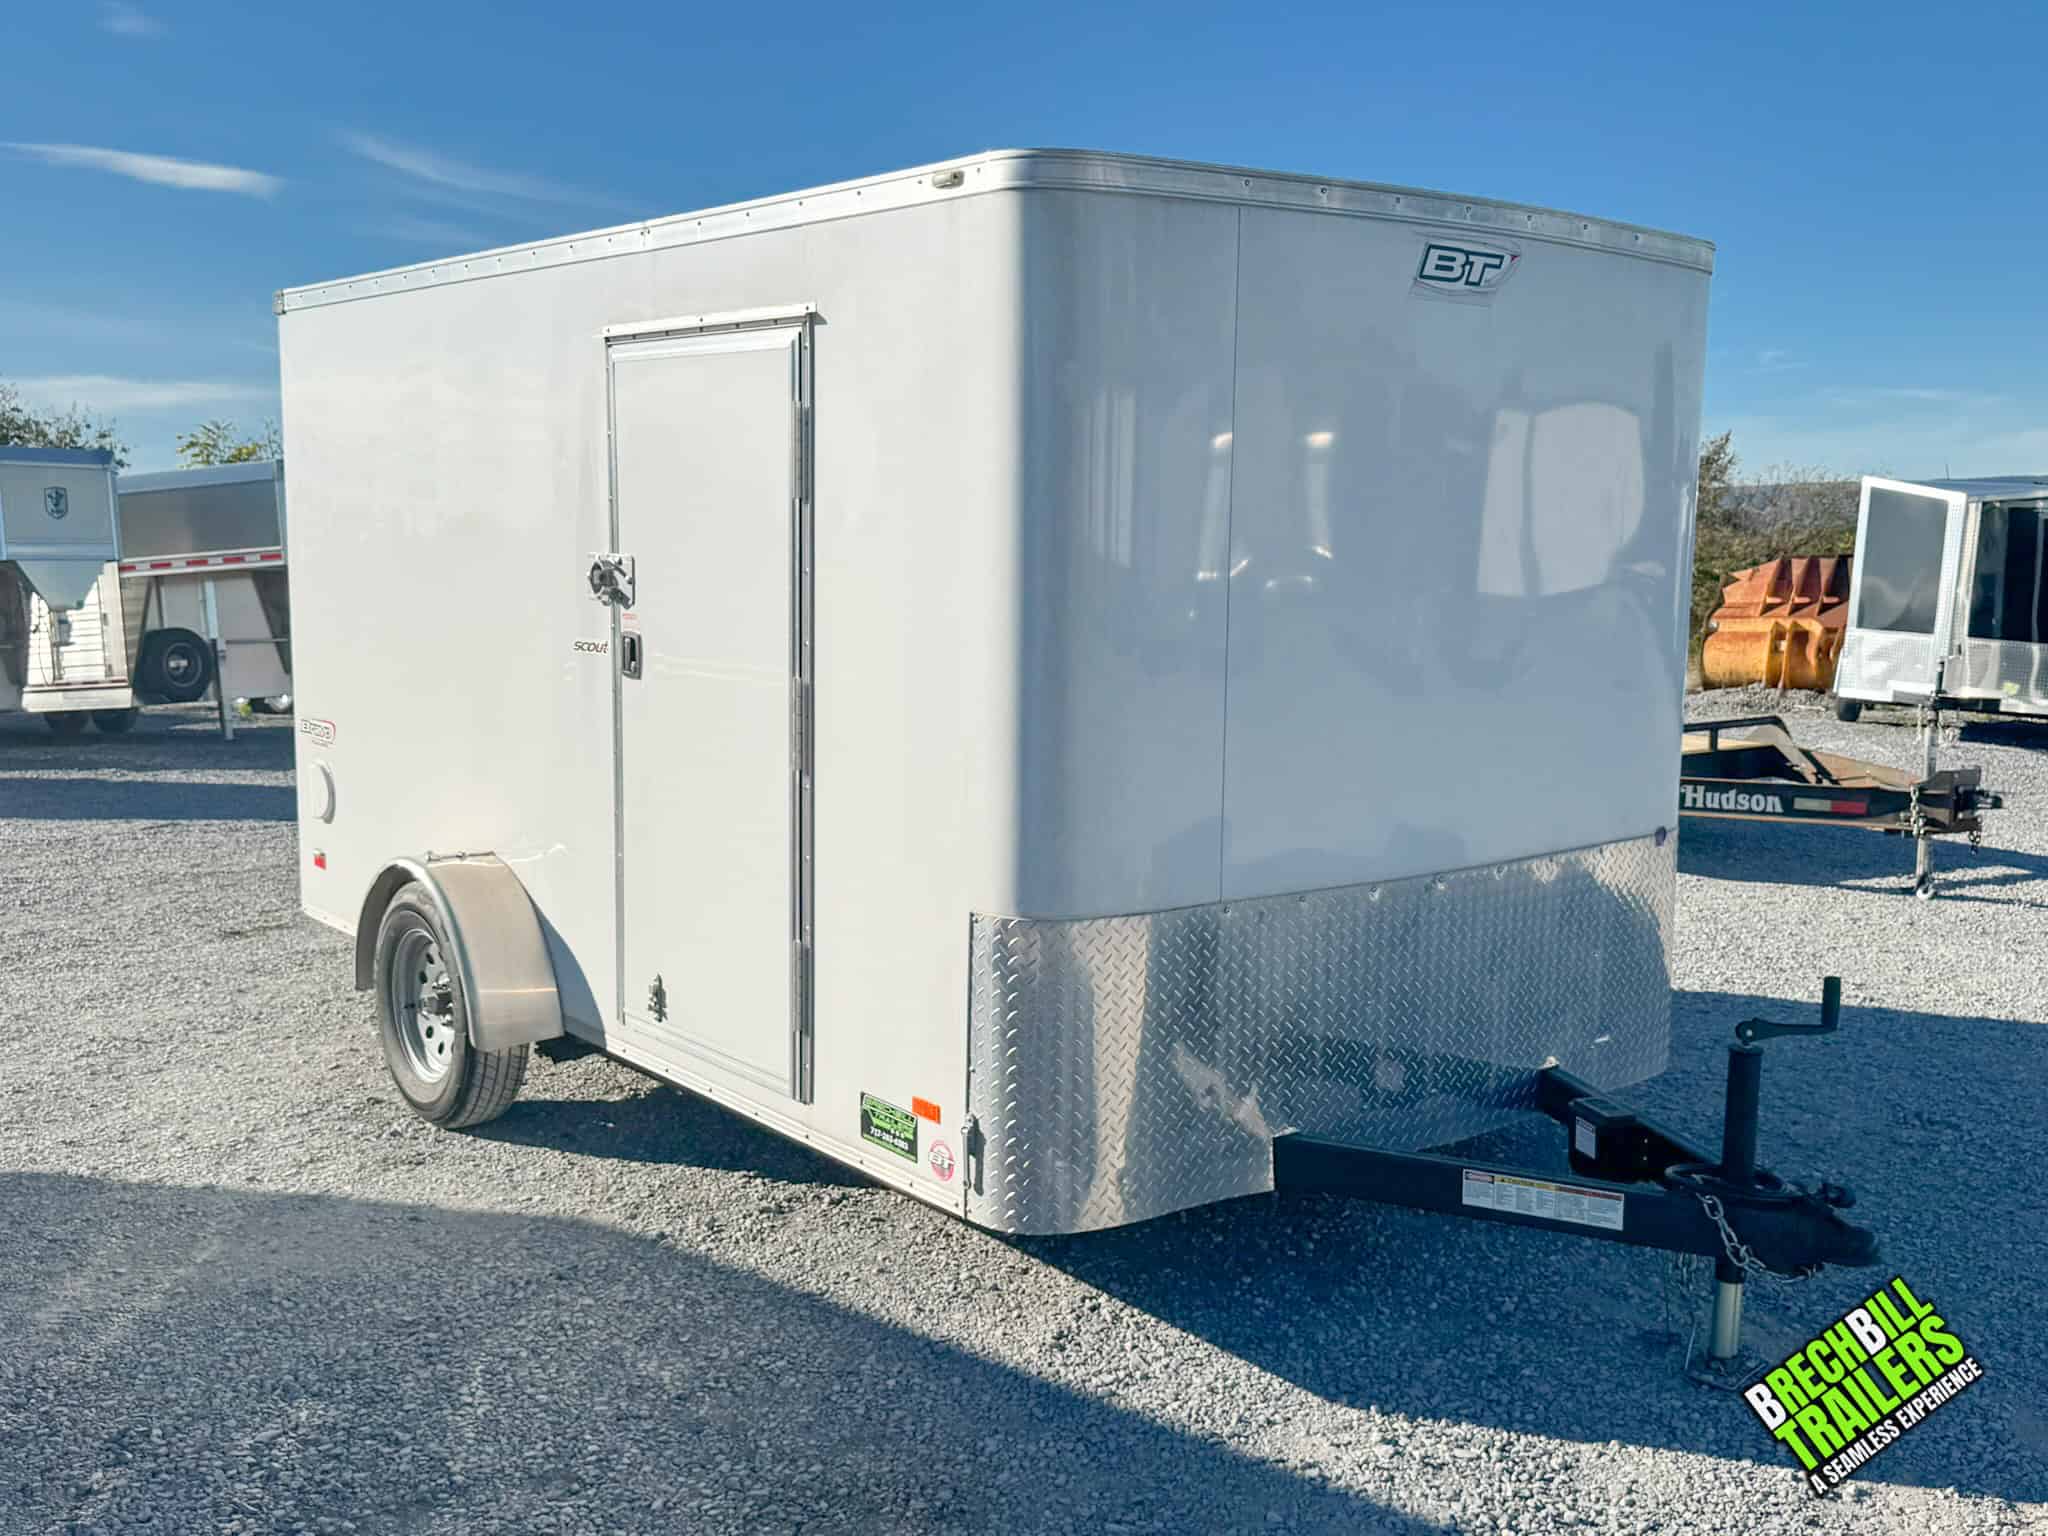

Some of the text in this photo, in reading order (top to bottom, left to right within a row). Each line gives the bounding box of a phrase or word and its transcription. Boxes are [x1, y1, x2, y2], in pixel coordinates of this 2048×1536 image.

[1419, 244, 1504, 287] BT
[573, 641, 609, 653] scout
[1680, 785, 1784, 813] Hudson
